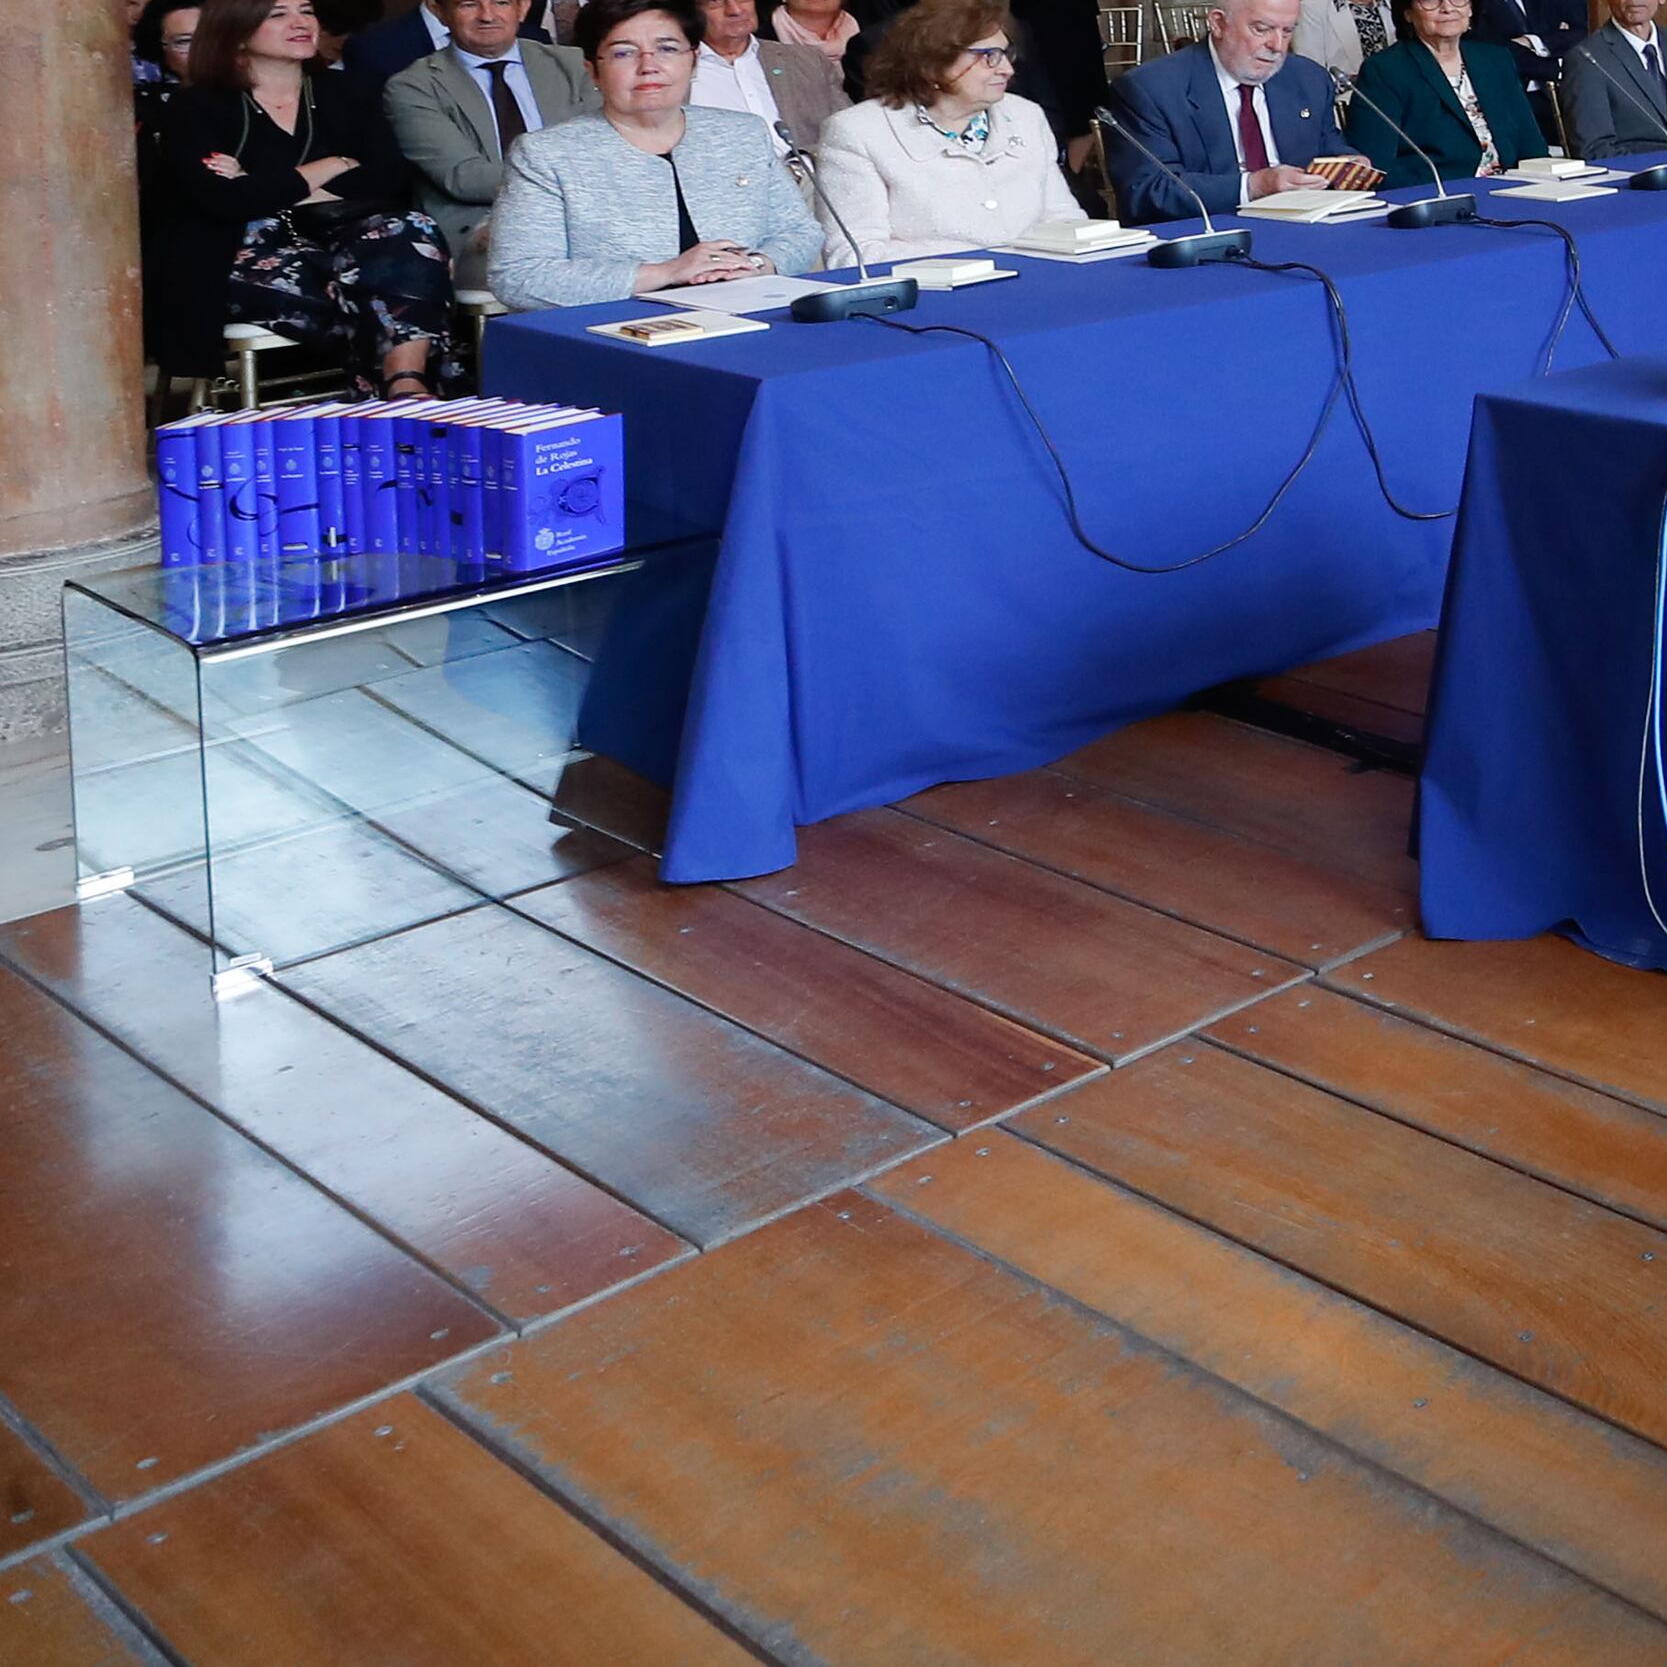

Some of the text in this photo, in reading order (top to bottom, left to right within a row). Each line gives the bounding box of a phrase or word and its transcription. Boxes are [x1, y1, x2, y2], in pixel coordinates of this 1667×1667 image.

[535, 438, 581, 453] Fernando
[535, 458, 593, 475] La Celestina
